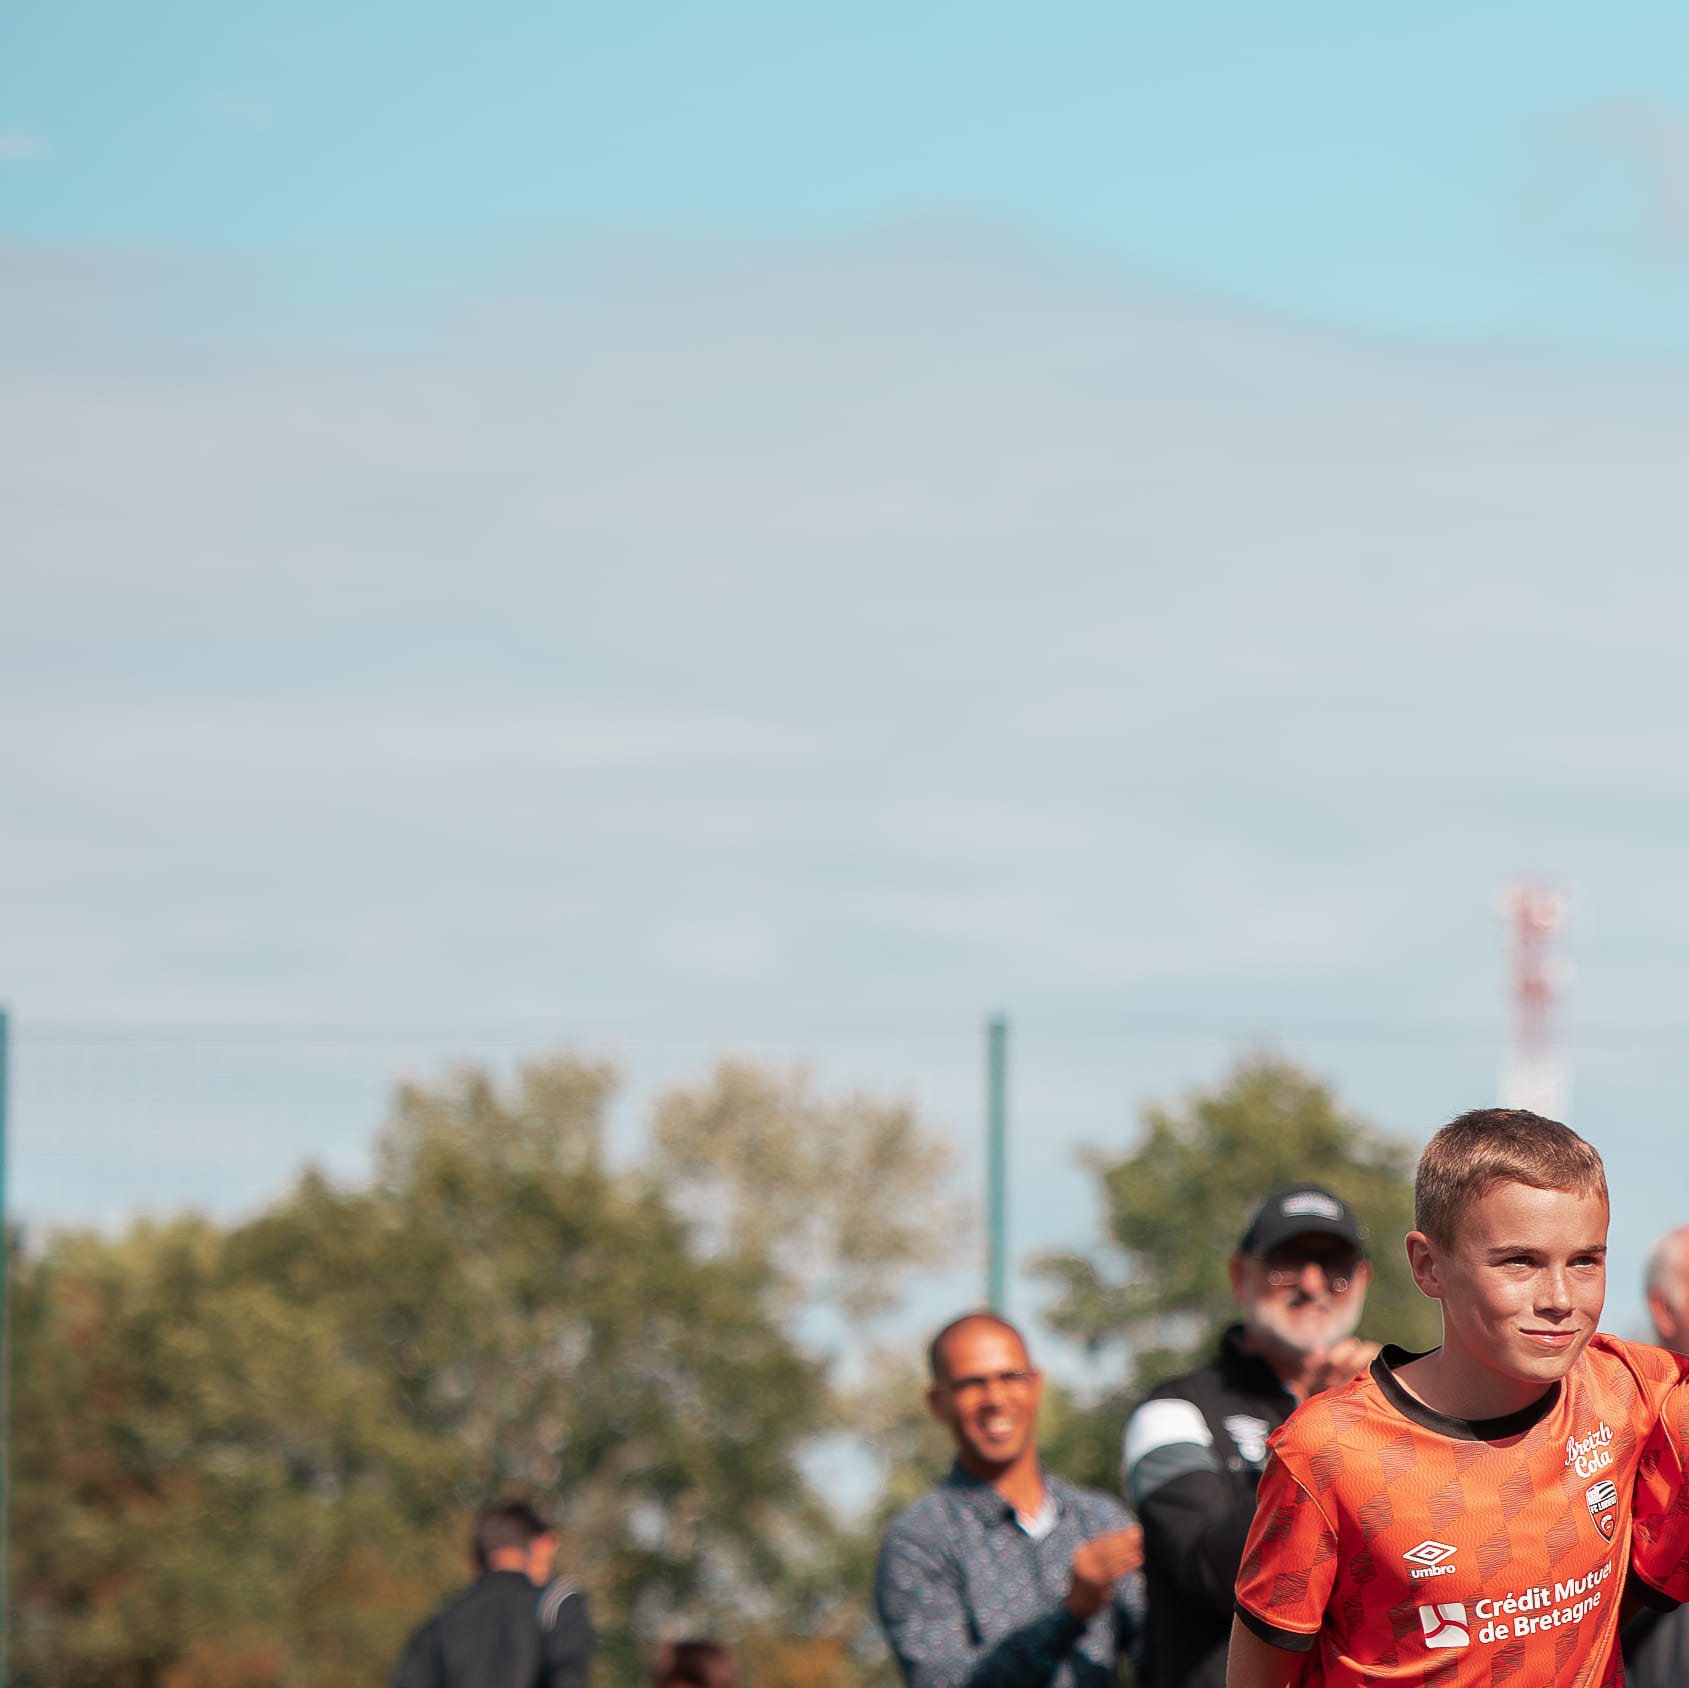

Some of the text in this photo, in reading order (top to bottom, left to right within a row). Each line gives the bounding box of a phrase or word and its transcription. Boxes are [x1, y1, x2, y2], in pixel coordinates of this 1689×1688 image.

[1565, 1421, 1613, 1466] Breizh
[1575, 1450, 1613, 1478] Cola
[1411, 1563, 1456, 1579] umbro
[1475, 1559, 1612, 1619] Crédit Mutuel
[1479, 1591, 1602, 1644] de Bretagne
